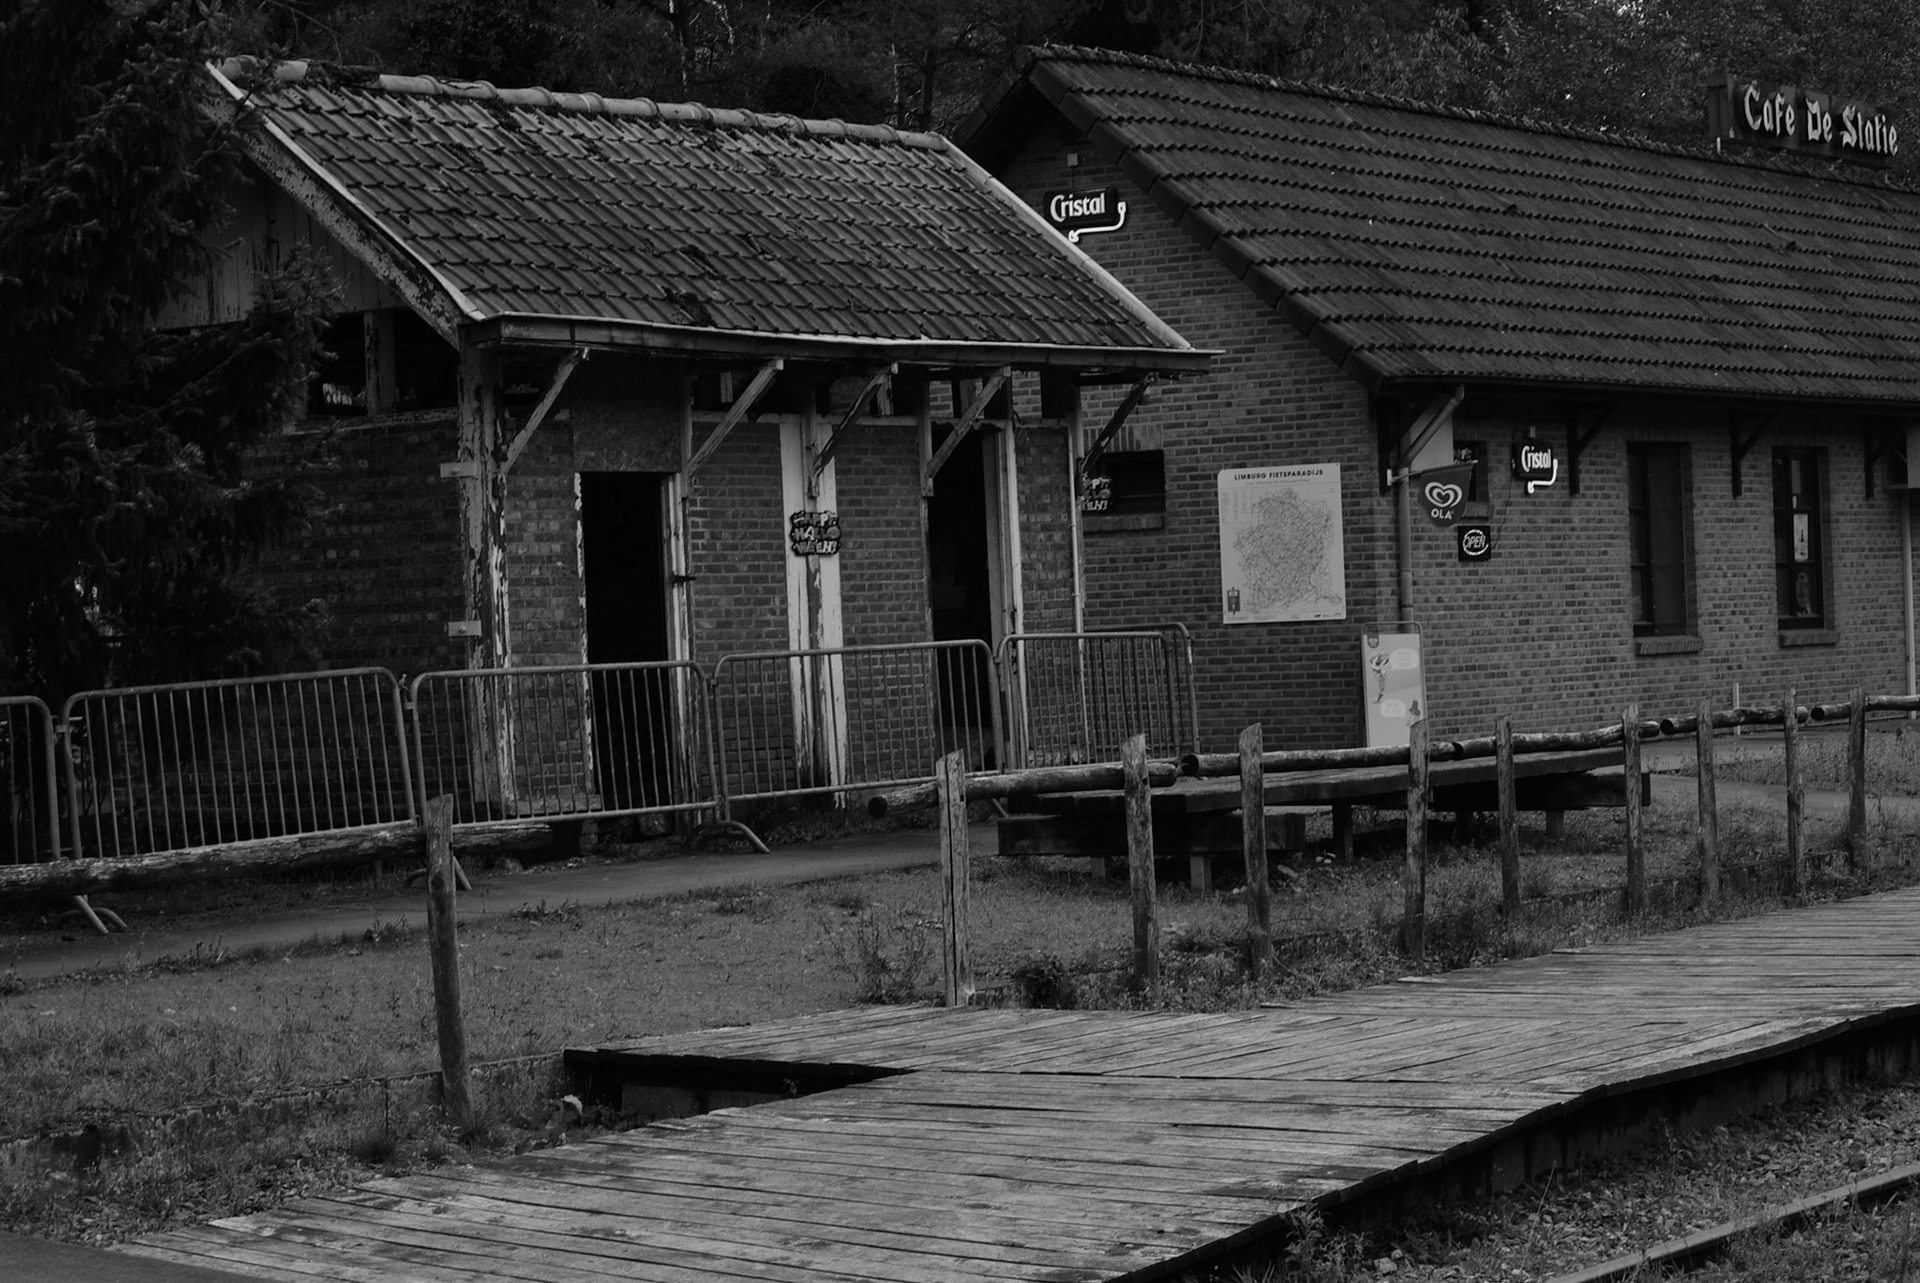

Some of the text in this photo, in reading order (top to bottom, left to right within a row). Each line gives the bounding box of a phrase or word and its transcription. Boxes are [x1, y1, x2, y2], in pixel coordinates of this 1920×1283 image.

[1805, 97, 1833, 143] De
[1840, 104, 1899, 157] Statie
[1050, 192, 1107, 222] Cristal
[1521, 445, 1552, 473] Cristal
[1234, 469, 1324, 480] LIMBURG FIETSPARADIJS
[1430, 508, 1452, 520] OLA
[1463, 536, 1486, 549] OPEN
